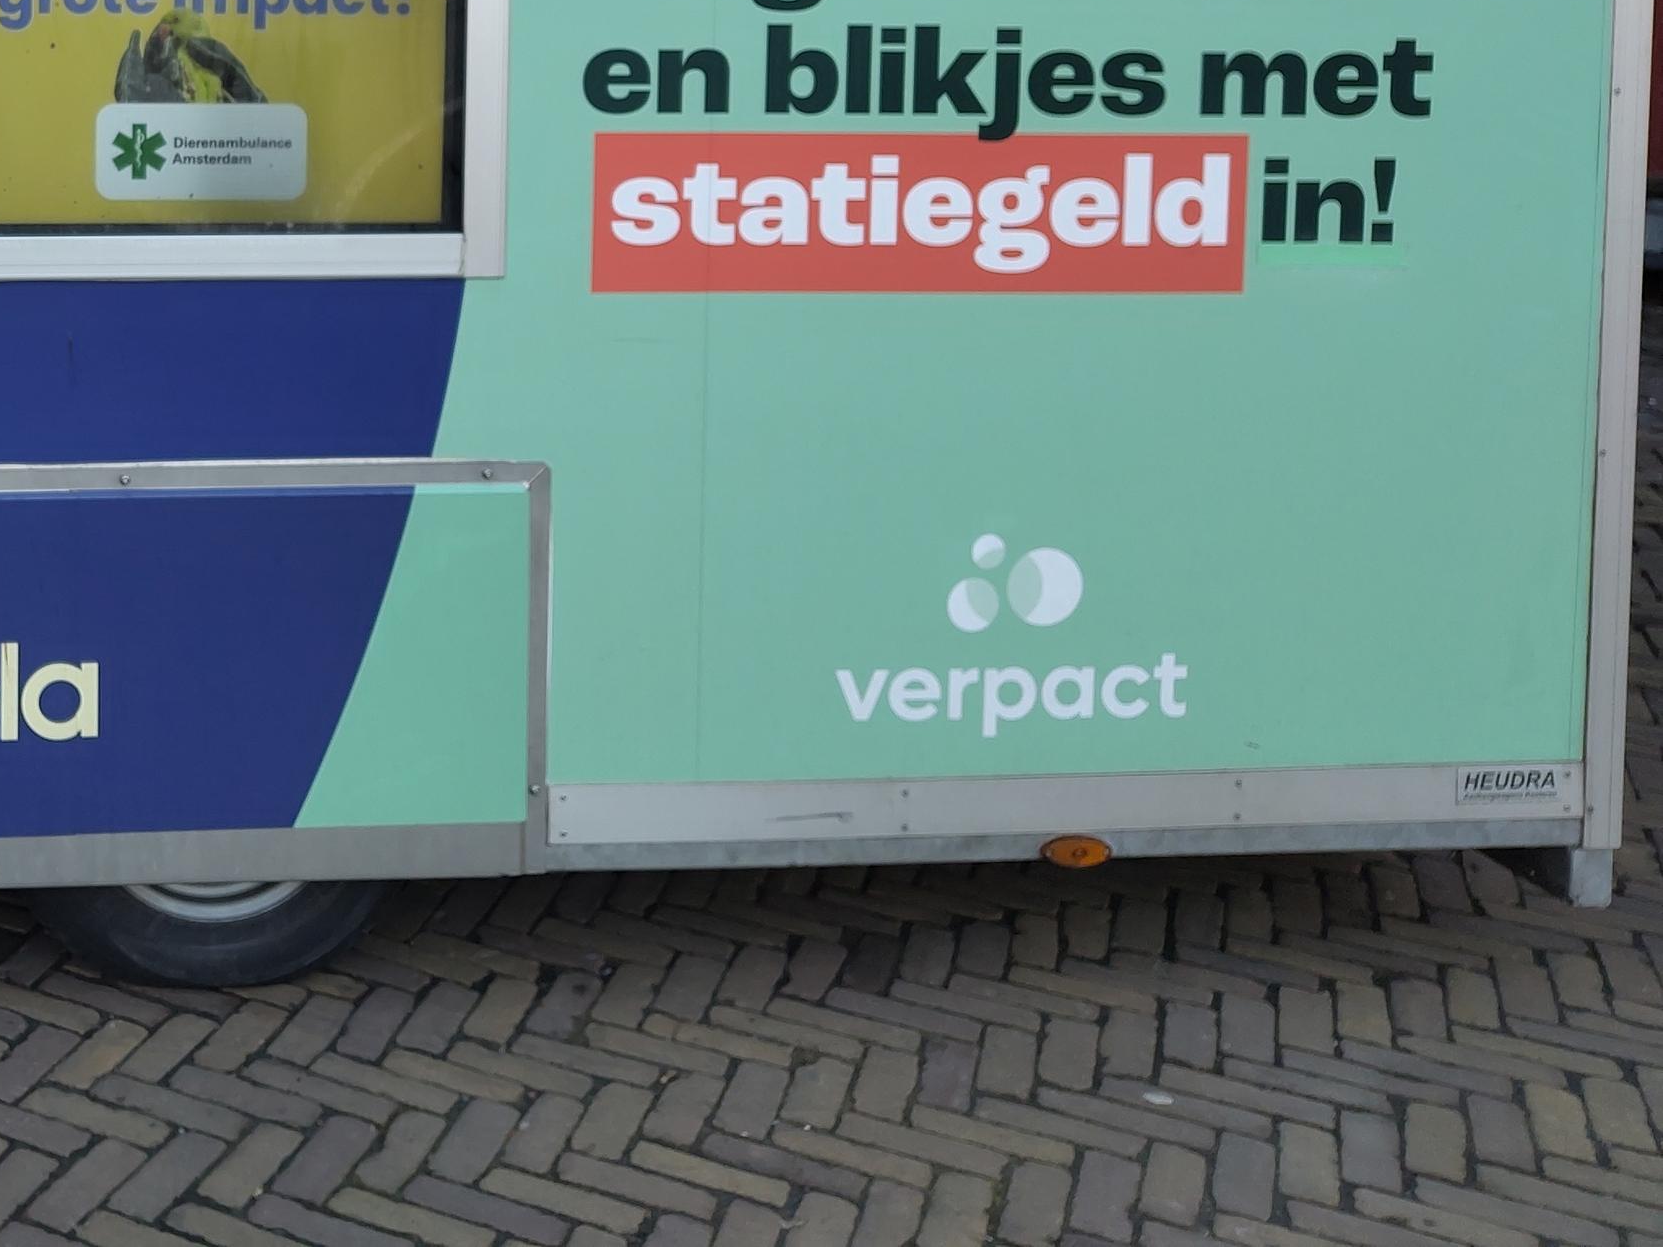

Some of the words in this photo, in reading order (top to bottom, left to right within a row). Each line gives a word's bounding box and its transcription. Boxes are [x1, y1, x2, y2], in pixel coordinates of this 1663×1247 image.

[582, 46, 732, 114] en
[764, 24, 1167, 142] blikjes
[1199, 39, 1435, 118] met
[172, 152, 252, 165] Amsterdam
[173, 136, 293, 149] Dierenambulance
[610, 154, 1231, 273] statiegeld
[1262, 157, 1397, 244] in!
[835, 652, 1188, 738] verpact
[1464, 769, 1556, 791] HEUDRA
